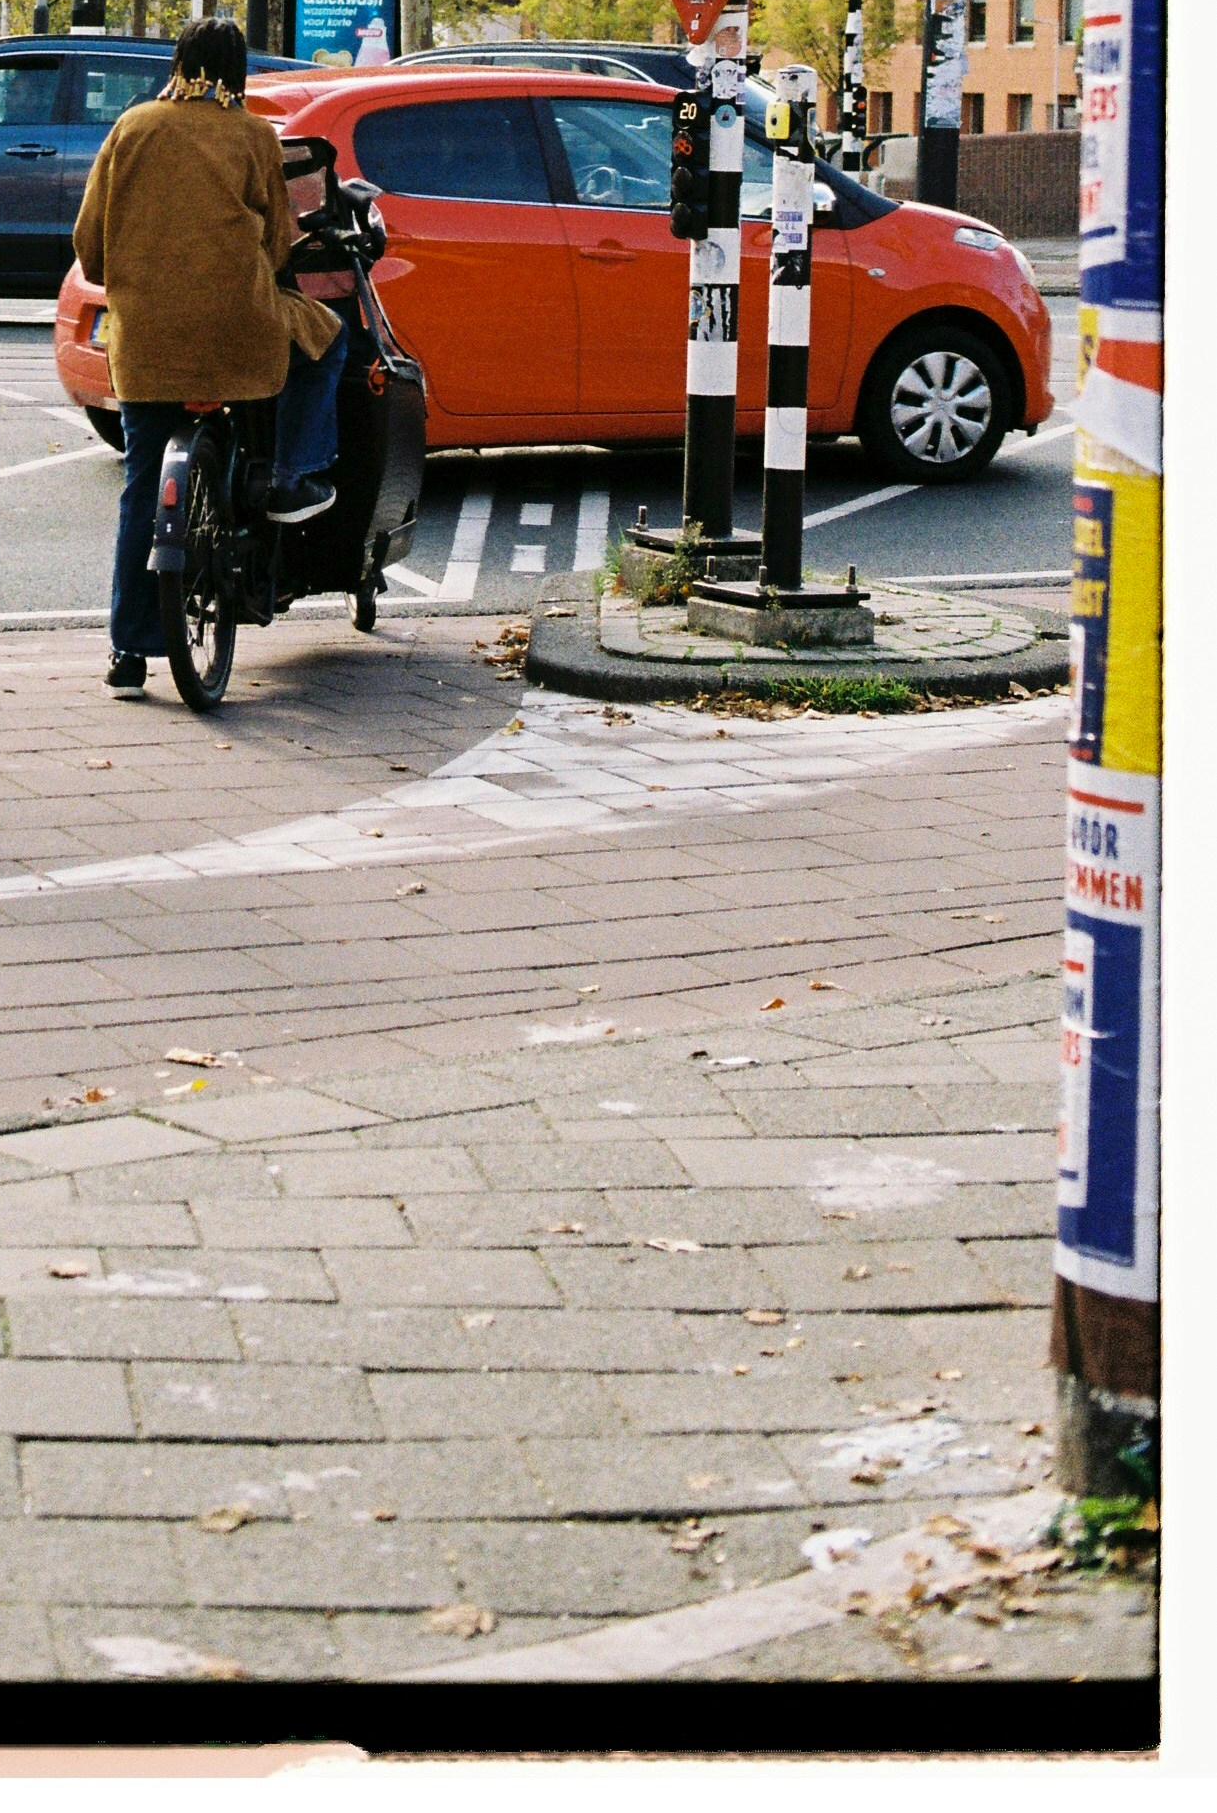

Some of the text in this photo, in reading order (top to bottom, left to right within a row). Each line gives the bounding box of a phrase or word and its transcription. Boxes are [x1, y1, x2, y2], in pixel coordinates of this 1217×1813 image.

[303, 7, 358, 16] wasmiddel
[303, 17, 353, 27] voor korte
[302, 29, 337, 39] wasjes
[680, 102, 697, 120] 20
